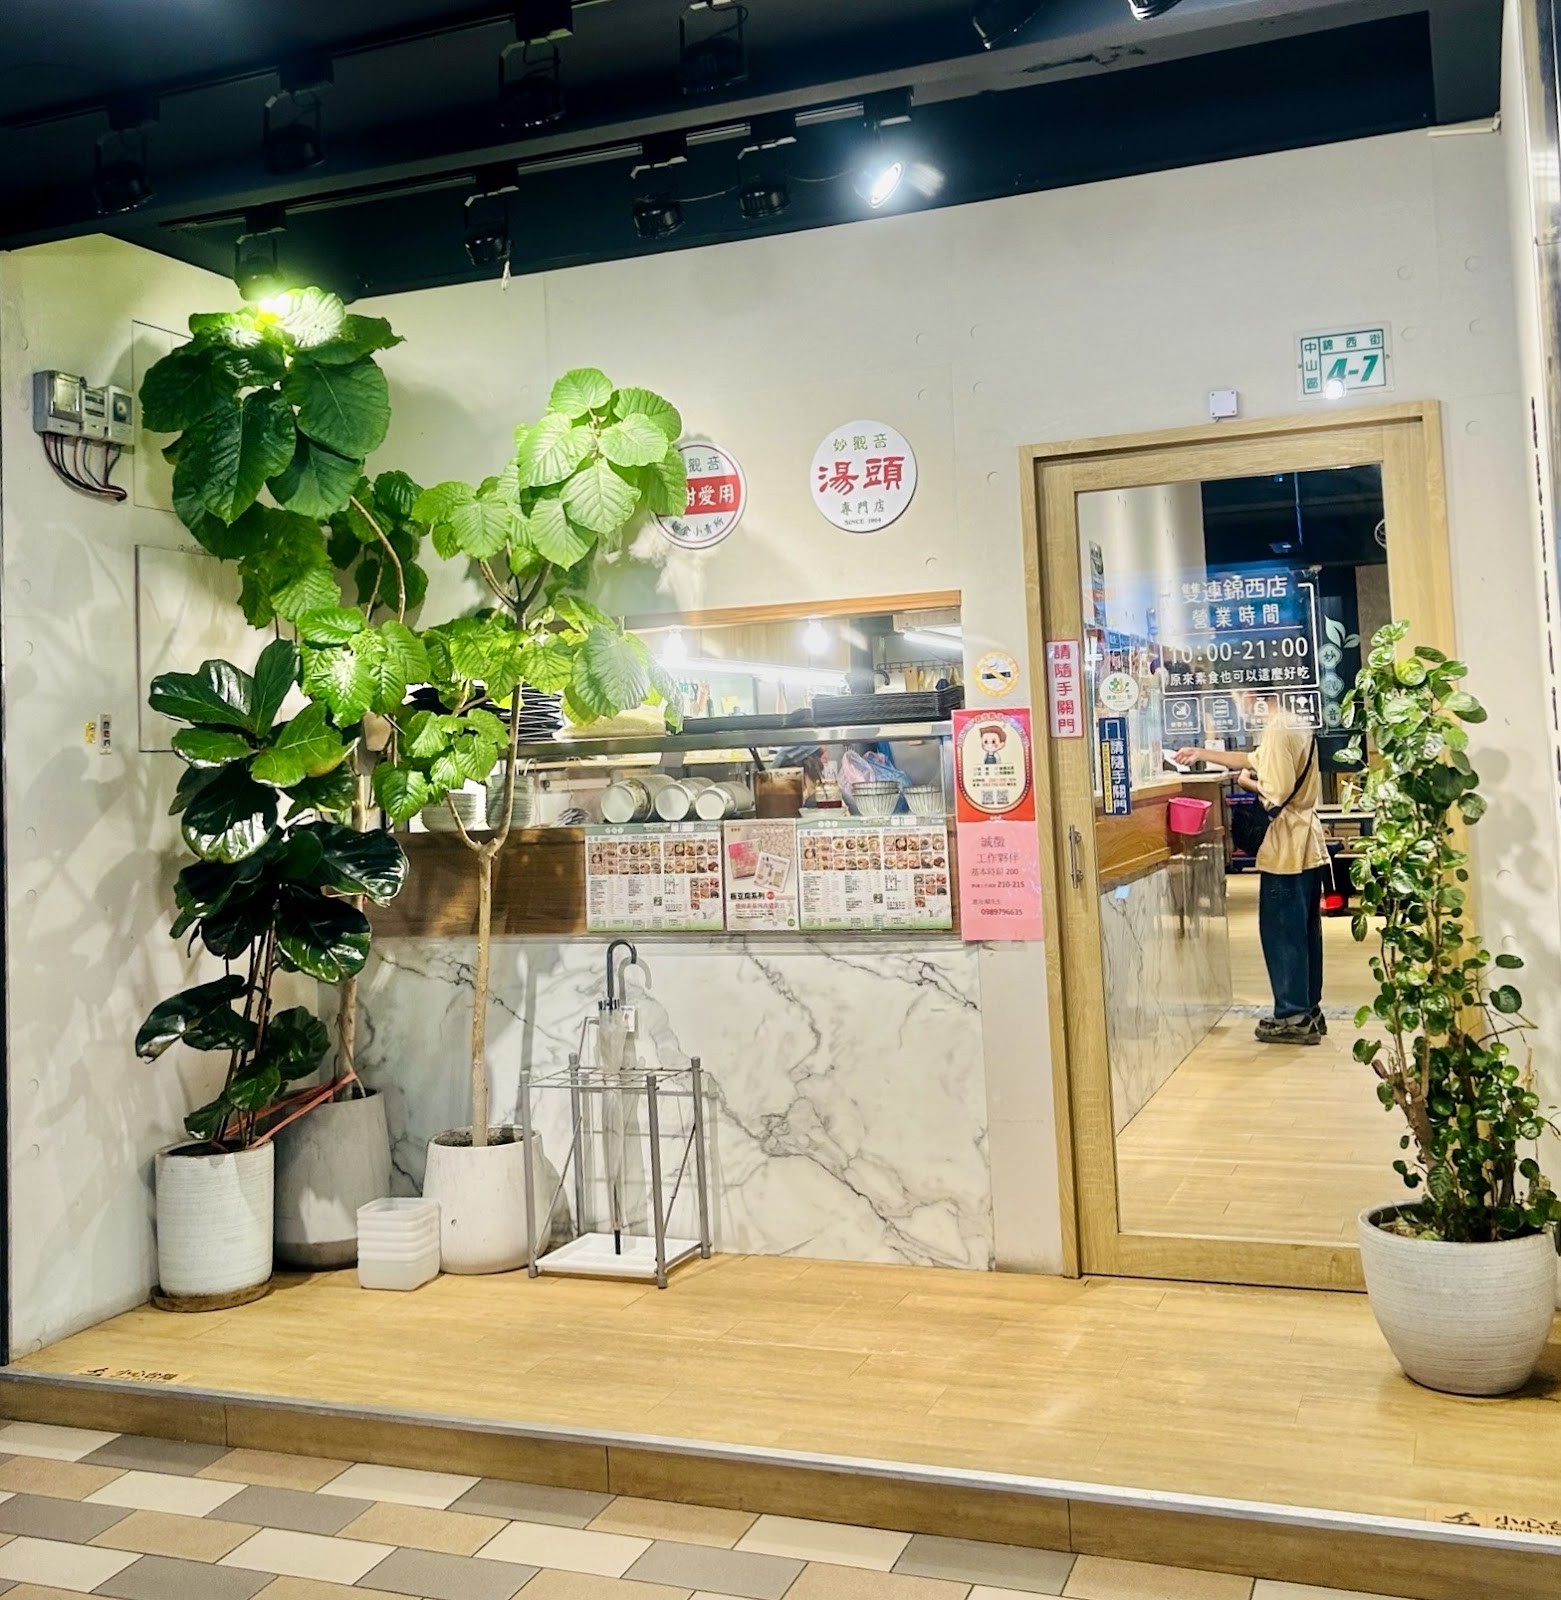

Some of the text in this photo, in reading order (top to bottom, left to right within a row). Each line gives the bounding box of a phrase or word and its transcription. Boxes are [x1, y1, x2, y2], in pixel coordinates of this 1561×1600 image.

[1323, 334, 1380, 351] 錦西街
[1304, 342, 1319, 390] 中山區
[1326, 354, 1379, 382] 4-7
[833, 433, 887, 452] 妙觀音
[817, 456, 905, 496] 湯頭
[840, 499, 885, 516] 專門店
[844, 518, 864, 526] SINCE
[1181, 575, 1288, 603] 雙連錦西店
[1192, 603, 1281, 631] 營業時間
[1168, 636, 1308, 664] 10:00-21:00
[1053, 645, 1075, 734] 請隨手關門
[1169, 666, 1311, 687] 原來素食也可以這麼好吃
[1110, 740, 1127, 814] 請隨手關門
[976, 852, 1018, 864] 工作夥伴
[1006, 868, 1019, 876] 200
